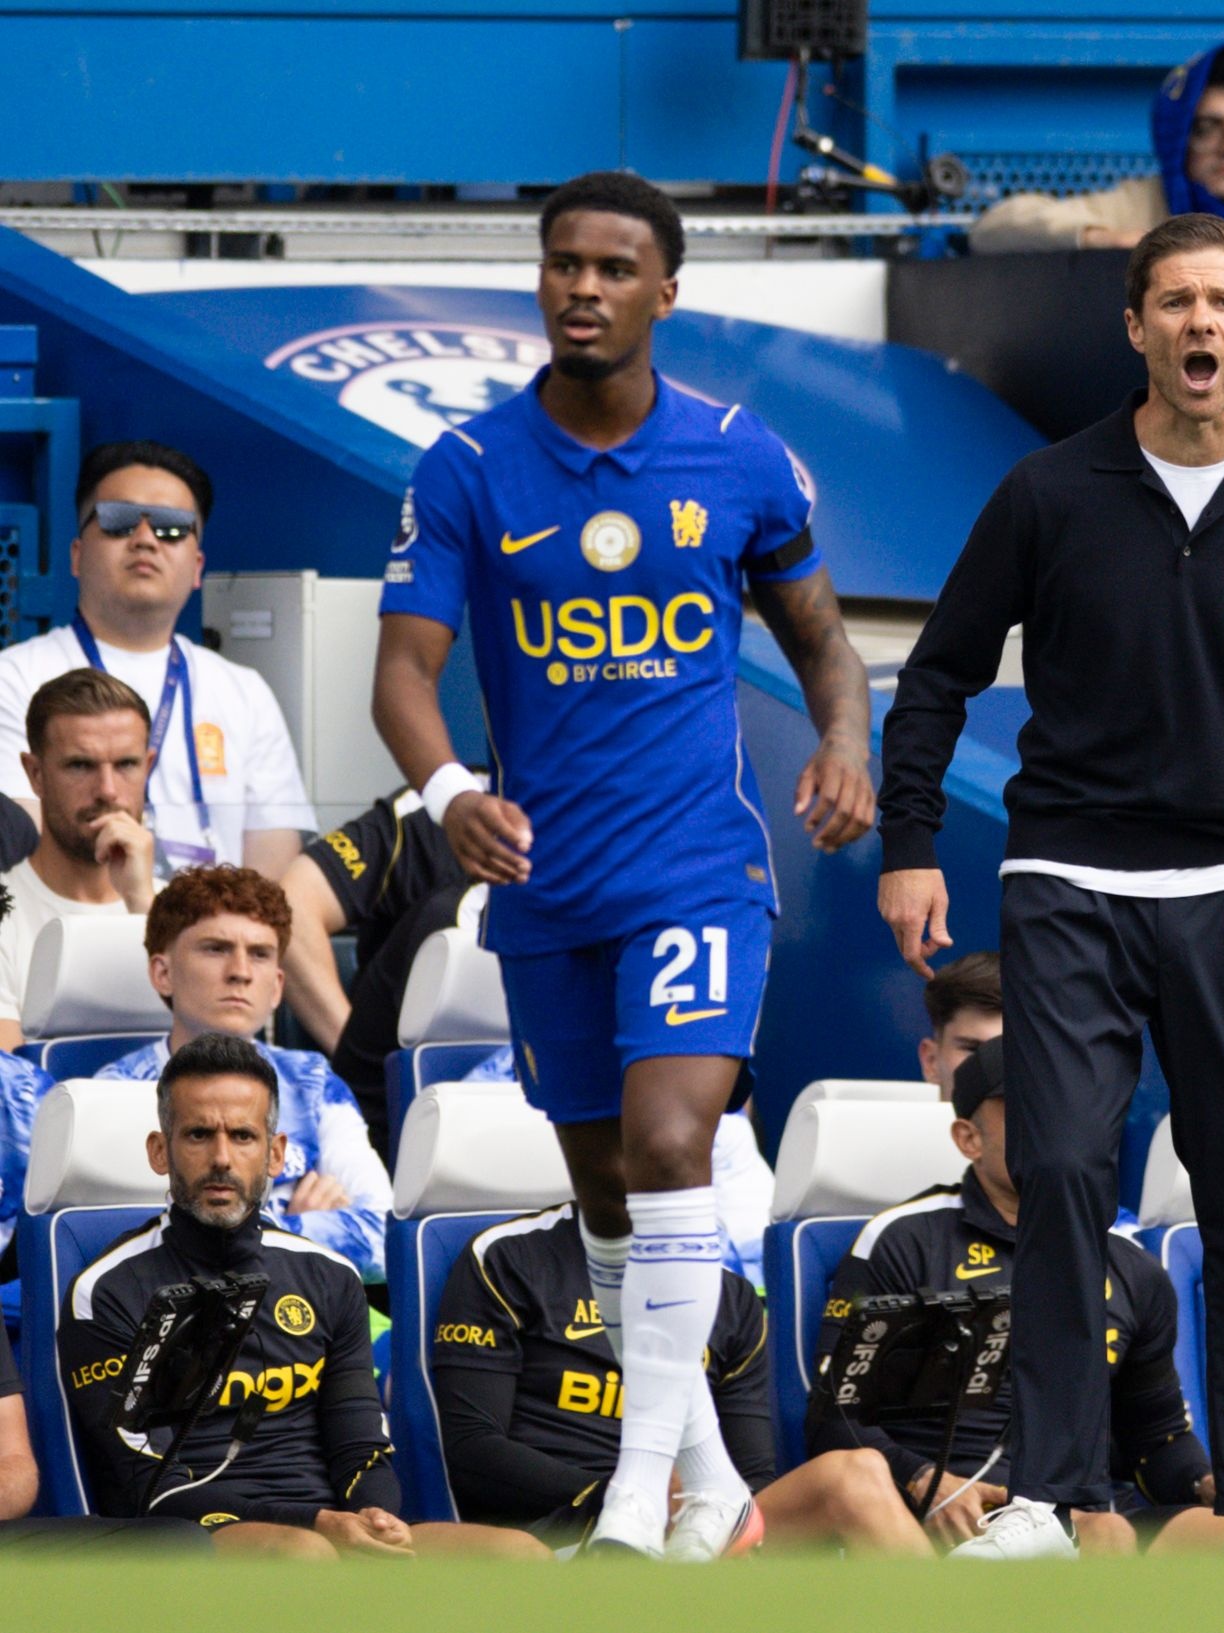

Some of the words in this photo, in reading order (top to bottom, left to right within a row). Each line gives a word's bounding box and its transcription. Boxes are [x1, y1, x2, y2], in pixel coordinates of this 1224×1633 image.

[290, 330, 552, 382] CHELSE
[511, 592, 714, 659] USDC
[573, 664, 598, 682] BY
[602, 658, 678, 681] CIRCLE
[650, 926, 728, 1007] 21
[968, 1242, 996, 1265] SP
[72, 1354, 127, 1389] LEGO
[133, 1313, 176, 1383] IFS.ai
[836, 1344, 880, 1405] IFS.ai
[966, 1331, 1010, 1394] IFS.ai
[557, 1370, 624, 1409] Bi
